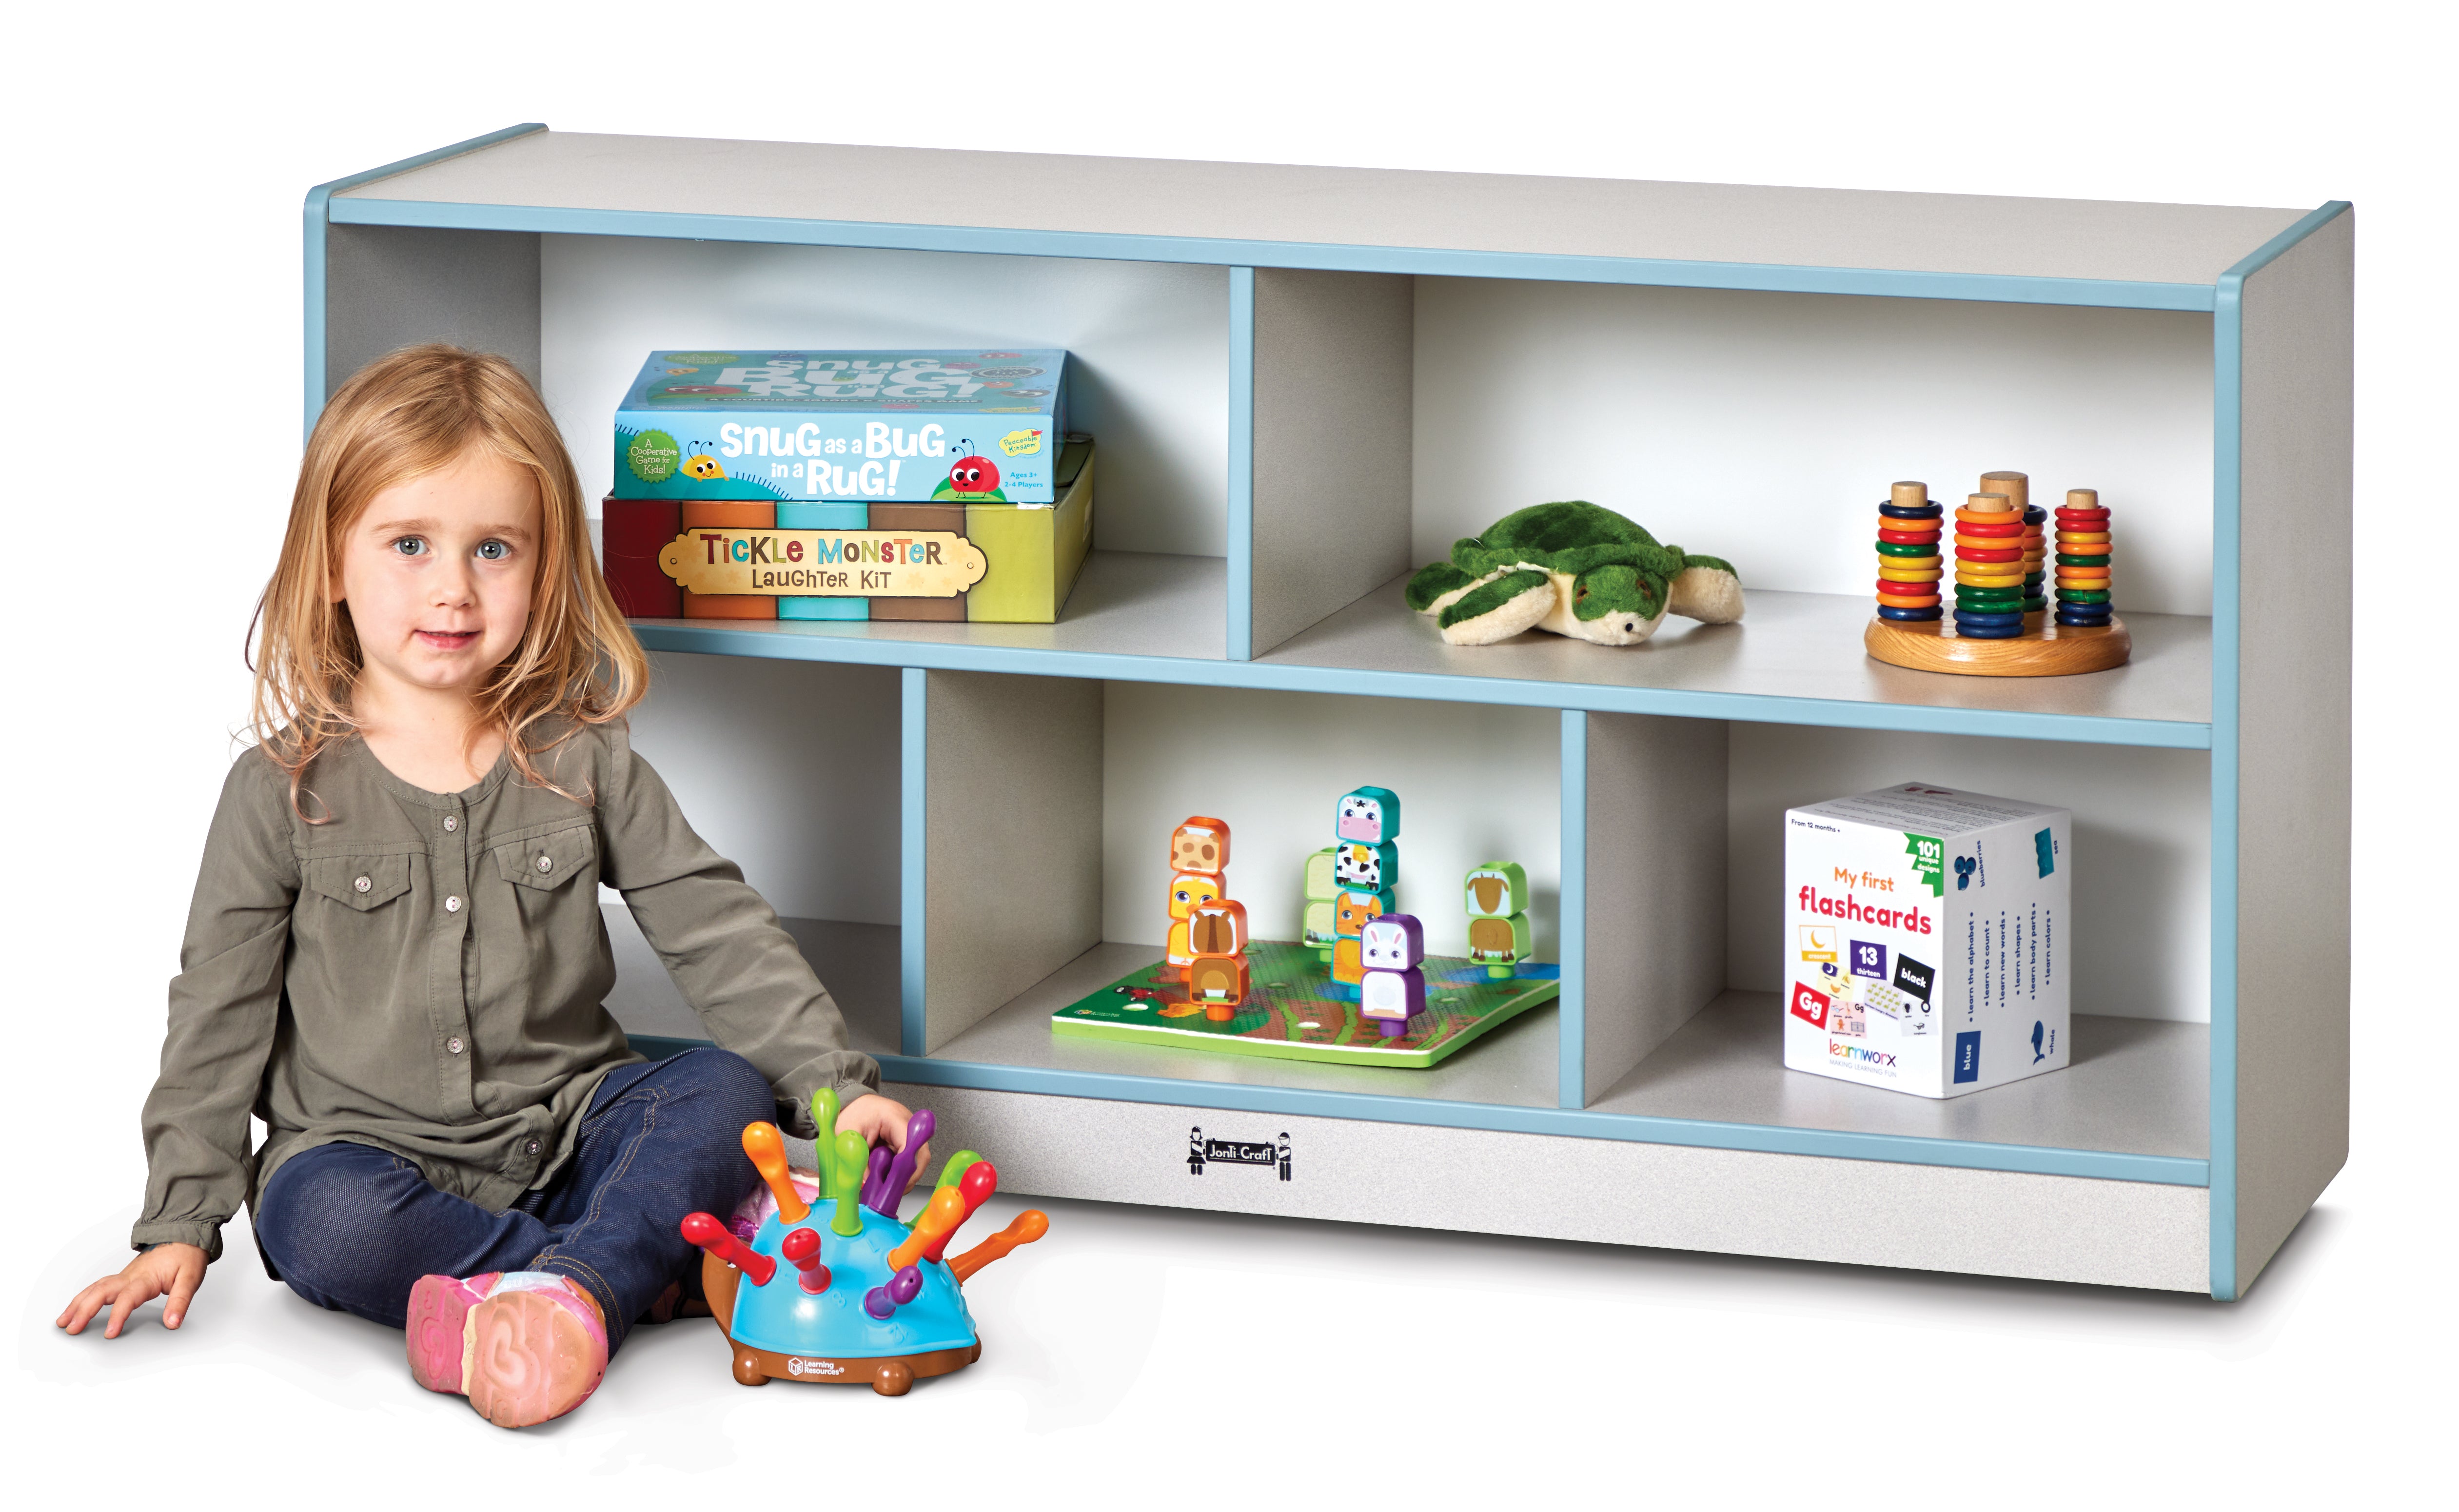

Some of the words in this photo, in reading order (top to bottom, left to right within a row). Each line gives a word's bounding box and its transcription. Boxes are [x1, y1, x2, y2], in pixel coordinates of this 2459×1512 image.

[644, 439, 653, 448] A
[825, 438, 846, 454] as
[851, 439, 863, 454] a
[1003, 435, 1038, 447] Peaceable
[1009, 443, 1036, 453] Kingdom
[631, 446, 677, 456] Cooperative
[636, 456, 660, 465] Game
[644, 464, 666, 474] Kids!
[771, 462, 788, 478] in
[792, 463, 803, 478] a
[1791, 819, 1806, 827] From
[1815, 823, 1836, 833] months
[1917, 841, 1940, 858] 101
[1919, 856, 1939, 864] unique
[1977, 840, 1986, 887] blueberries
[1917, 863, 1940, 873] designs
[1835, 866, 1857, 889] My
[1862, 871, 1894, 892] first
[1799, 885, 1931, 935] flashcards
[1859, 946, 1878, 966] 13
[1984, 959, 1989, 970] to
[1857, 968, 1881, 977] thirteen
[1901, 968, 1926, 988] black
[1799, 992, 1823, 1020] Gg
[1855, 1003, 1864, 1013] Gg
[1829, 1038, 1896, 1067] learnworx
[1963, 1044, 1972, 1070] blue
[1829, 1059, 1853, 1069] MAKING
[1854, 1064, 1883, 1075] LEARNING
[805, 1360, 834, 1369] Learning
